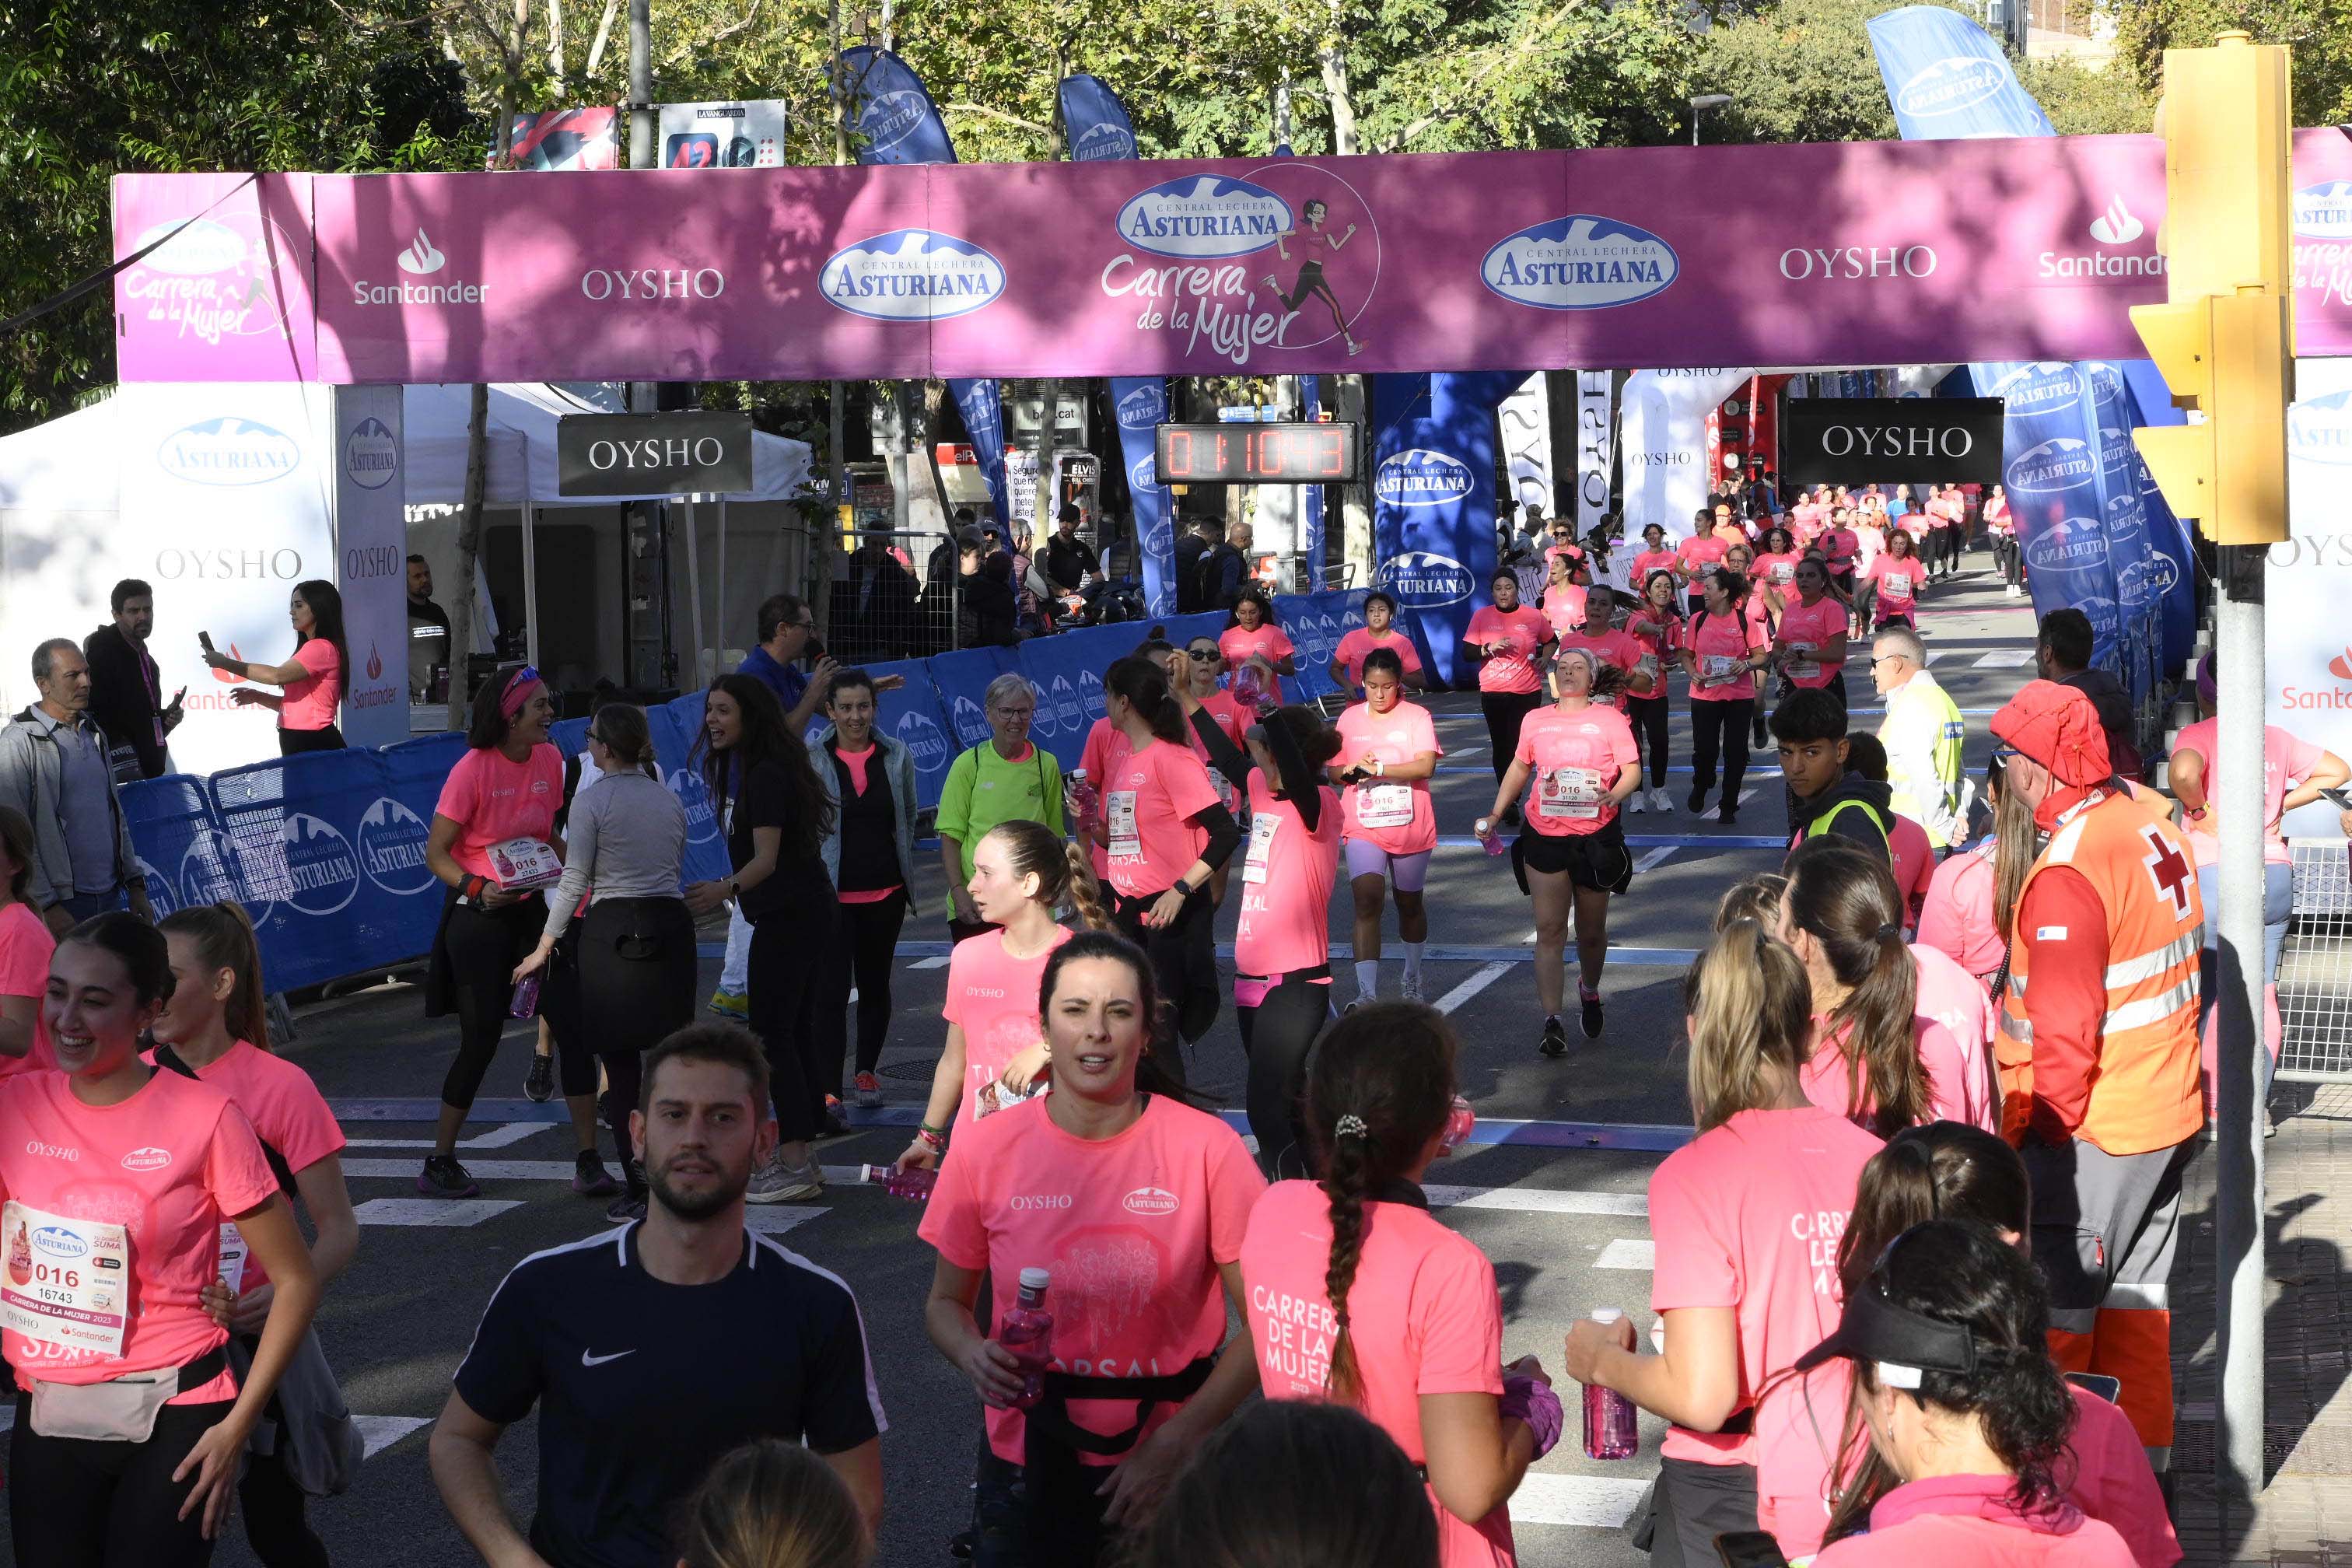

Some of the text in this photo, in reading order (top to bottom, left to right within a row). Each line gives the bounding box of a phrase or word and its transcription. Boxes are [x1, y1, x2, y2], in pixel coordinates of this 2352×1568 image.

[1157, 202, 1275, 212] CENTRAL LECHERA
[1130, 206, 1280, 238] ASTURIANA
[1526, 246, 1657, 258] CENTRAL LECHERA
[1780, 245, 1937, 280] OYSHO
[861, 260, 985, 270] CENTRAL LECHERA
[1101, 254, 1246, 299] Carrera
[1496, 251, 1664, 286] ASTURIANA
[124, 268, 217, 299] Carrera
[355, 280, 490, 305] Santander
[582, 268, 725, 300] OYSHO
[833, 263, 992, 298] ASTURIANA
[178, 296, 252, 345] Mujer
[1136, 291, 1301, 366] de la Mujer
[588, 436, 724, 471] OYSHO
[1822, 425, 1973, 458] OYSHO
[170, 443, 290, 469] ASTURIANA
[349, 450, 394, 473] ASTURIANA
[1631, 451, 1692, 467] OYSHO
[1071, 465, 1096, 474] ELVIS
[1379, 466, 1467, 493] ASTURIANA
[1014, 478, 1027, 489] que
[156, 548, 303, 580] OYSHO
[347, 544, 398, 580] OYSHO
[353, 684, 397, 711] Santander
[515, 857, 538, 870] 016
[521, 868, 540, 877] 27433
[967, 986, 1005, 999] OYSHO
[26, 1140, 79, 1163] OYSHO
[1010, 1194, 1073, 1212] OYSHO
[1125, 1196, 1177, 1210] ASTURIANA
[34, 1234, 83, 1254] ASTURIANA
[93, 1241, 121, 1251] SUMA
[35, 1263, 79, 1287] 016
[38, 1287, 73, 1304] 16743
[9, 1294, 112, 1324] CARRERA DE LA MUJER 2023
[7, 1310, 114, 1343] OYSHO Santander
[1269, 1318, 1328, 1361] DE LA
[1290, 1381, 1311, 1395] 2023
